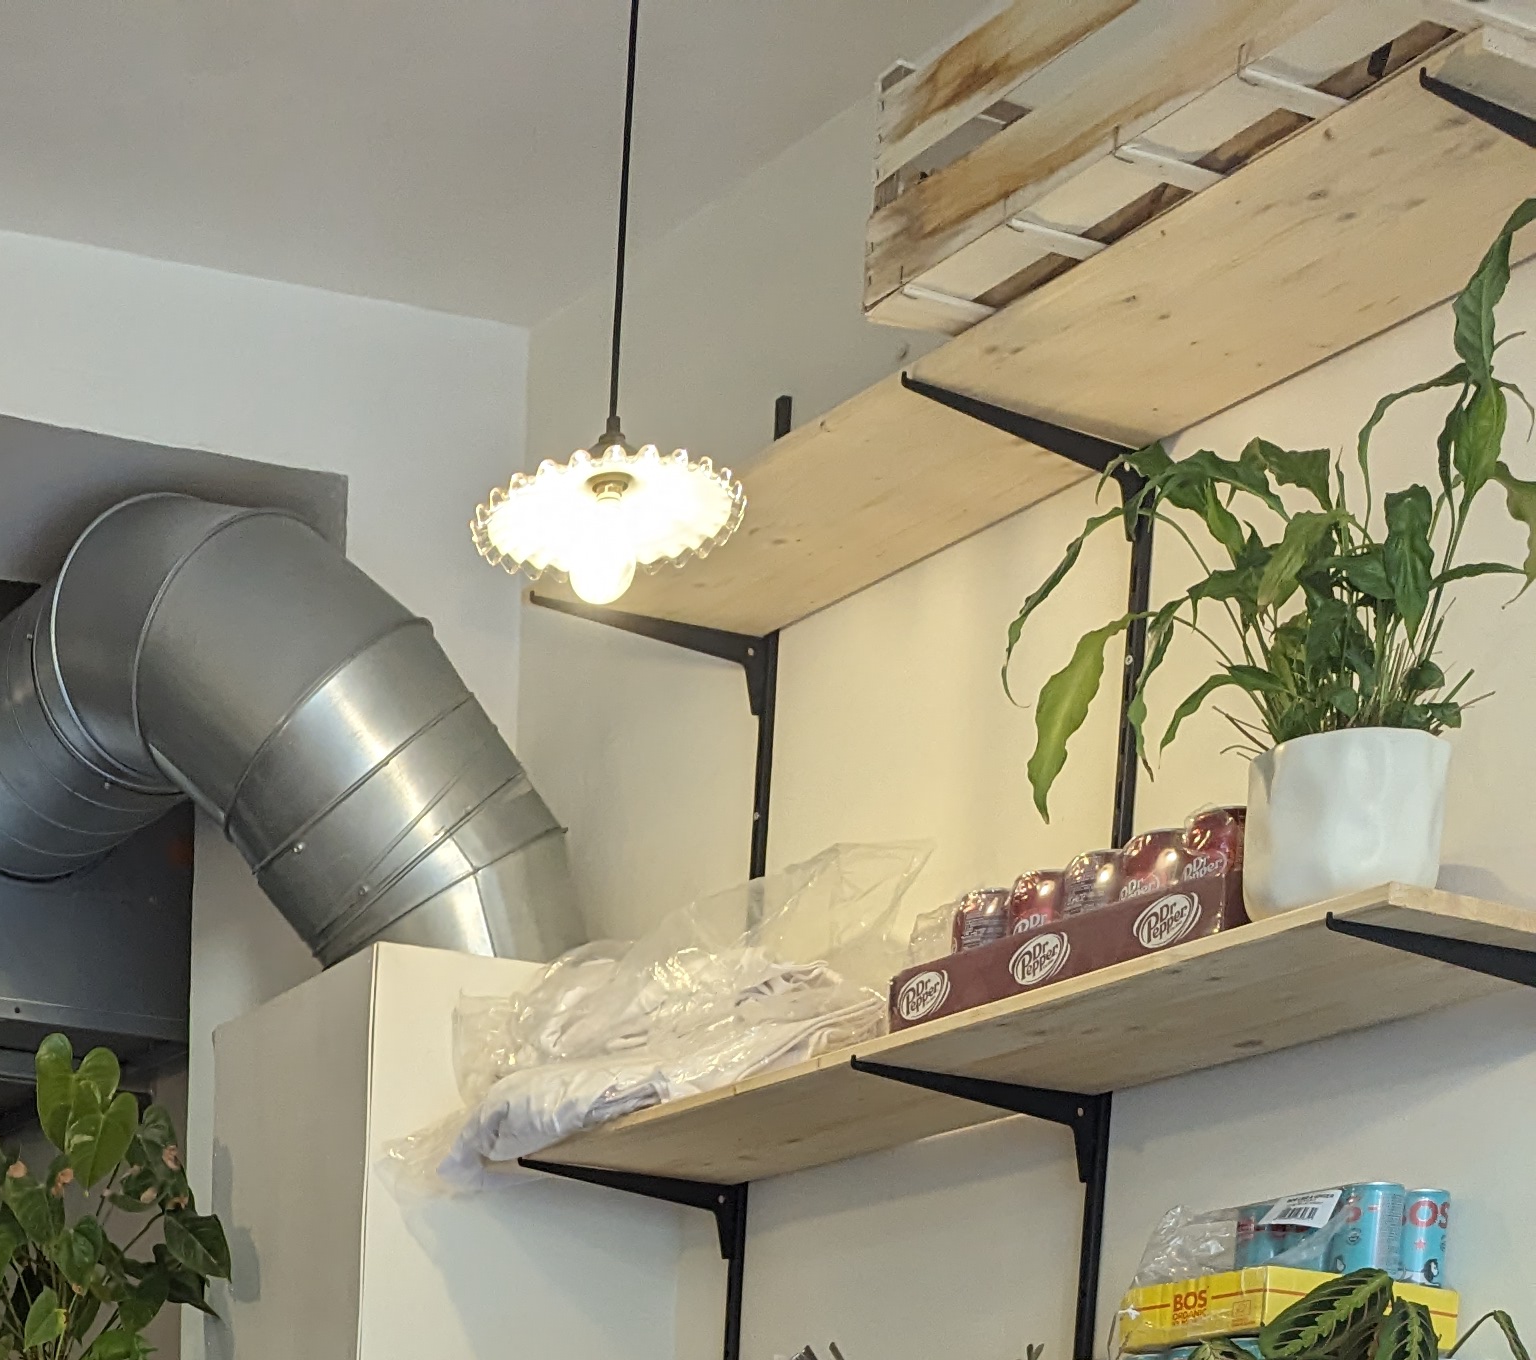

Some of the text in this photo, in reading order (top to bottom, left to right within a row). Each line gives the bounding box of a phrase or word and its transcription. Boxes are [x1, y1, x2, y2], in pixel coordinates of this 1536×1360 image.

[1159, 900, 1177, 920] Dr
[1146, 904, 1188, 944] Pepper
[1020, 944, 1059, 980] Pepper
[1032, 940, 1050, 958] Dr
[904, 981, 941, 1016] Pepper
[915, 977, 931, 995] Dr
[1401, 1200, 1451, 1229] OS
[1173, 1289, 1208, 1312] BOS
